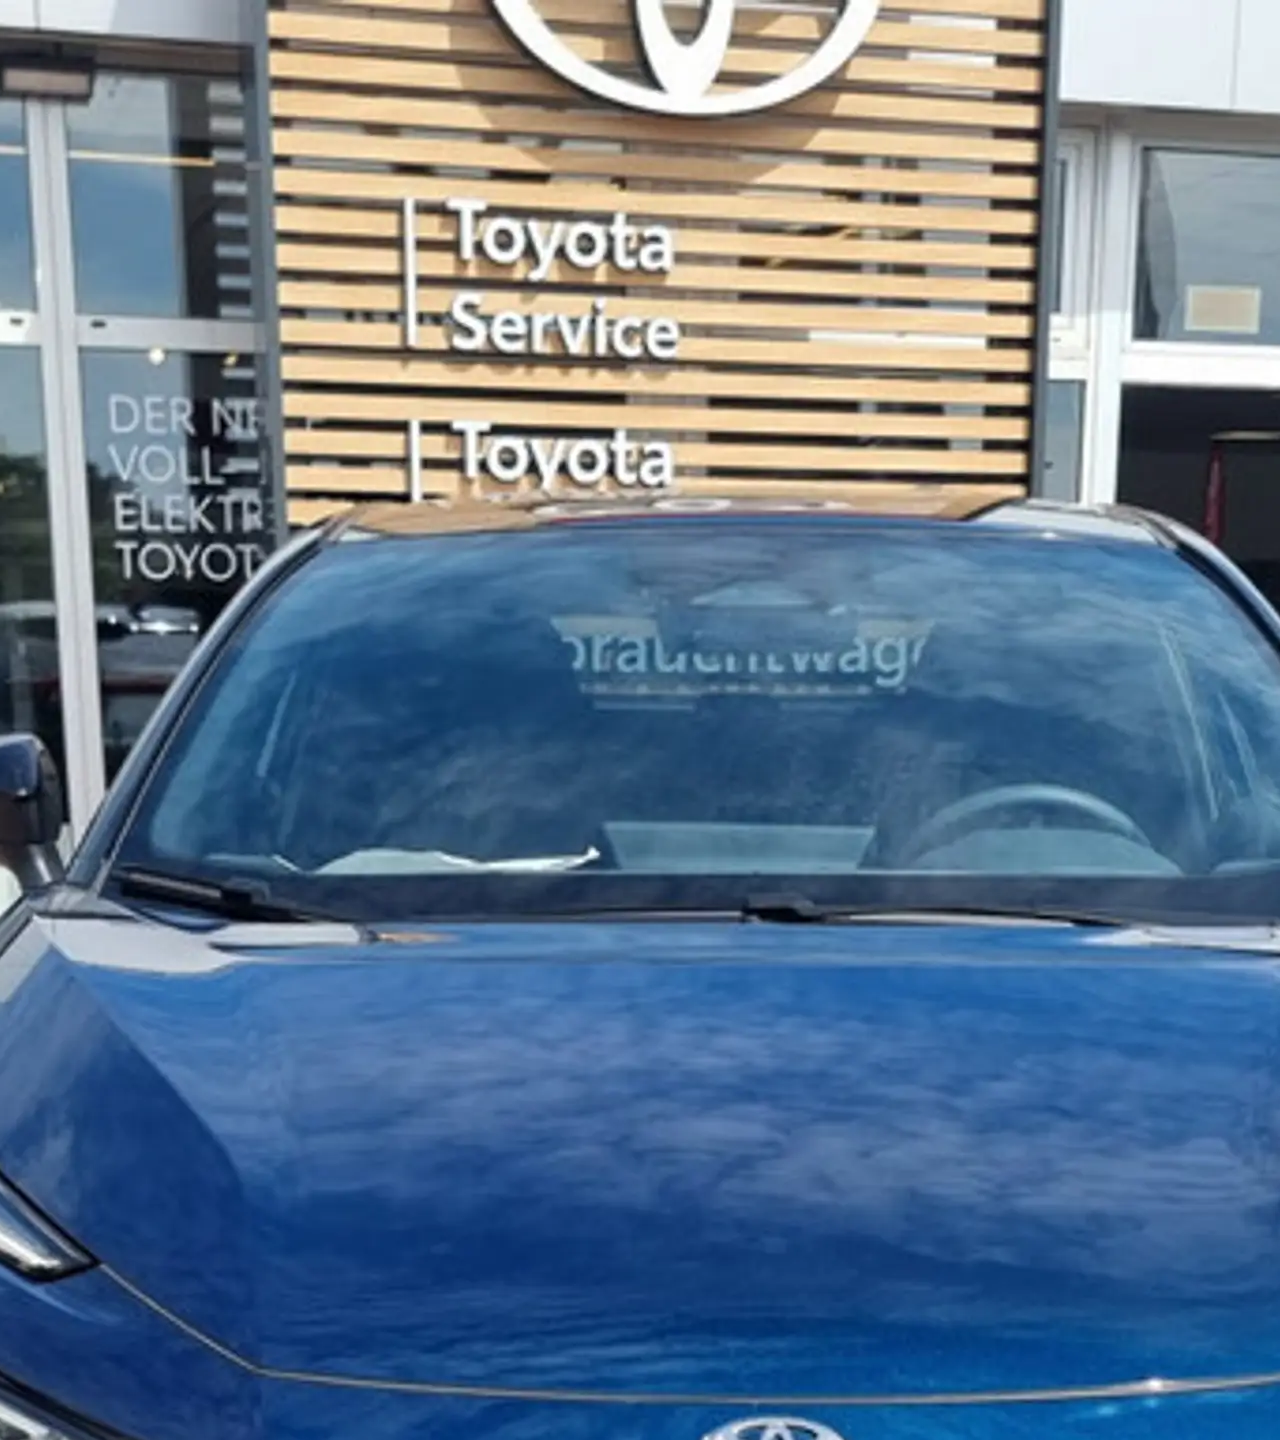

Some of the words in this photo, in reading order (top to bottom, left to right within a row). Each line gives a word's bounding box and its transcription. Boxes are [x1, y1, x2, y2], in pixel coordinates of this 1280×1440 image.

[446, 199, 675, 282] Toyota
[451, 292, 679, 358] Service
[109, 394, 195, 436] DER
[452, 421, 673, 489] Toyota
